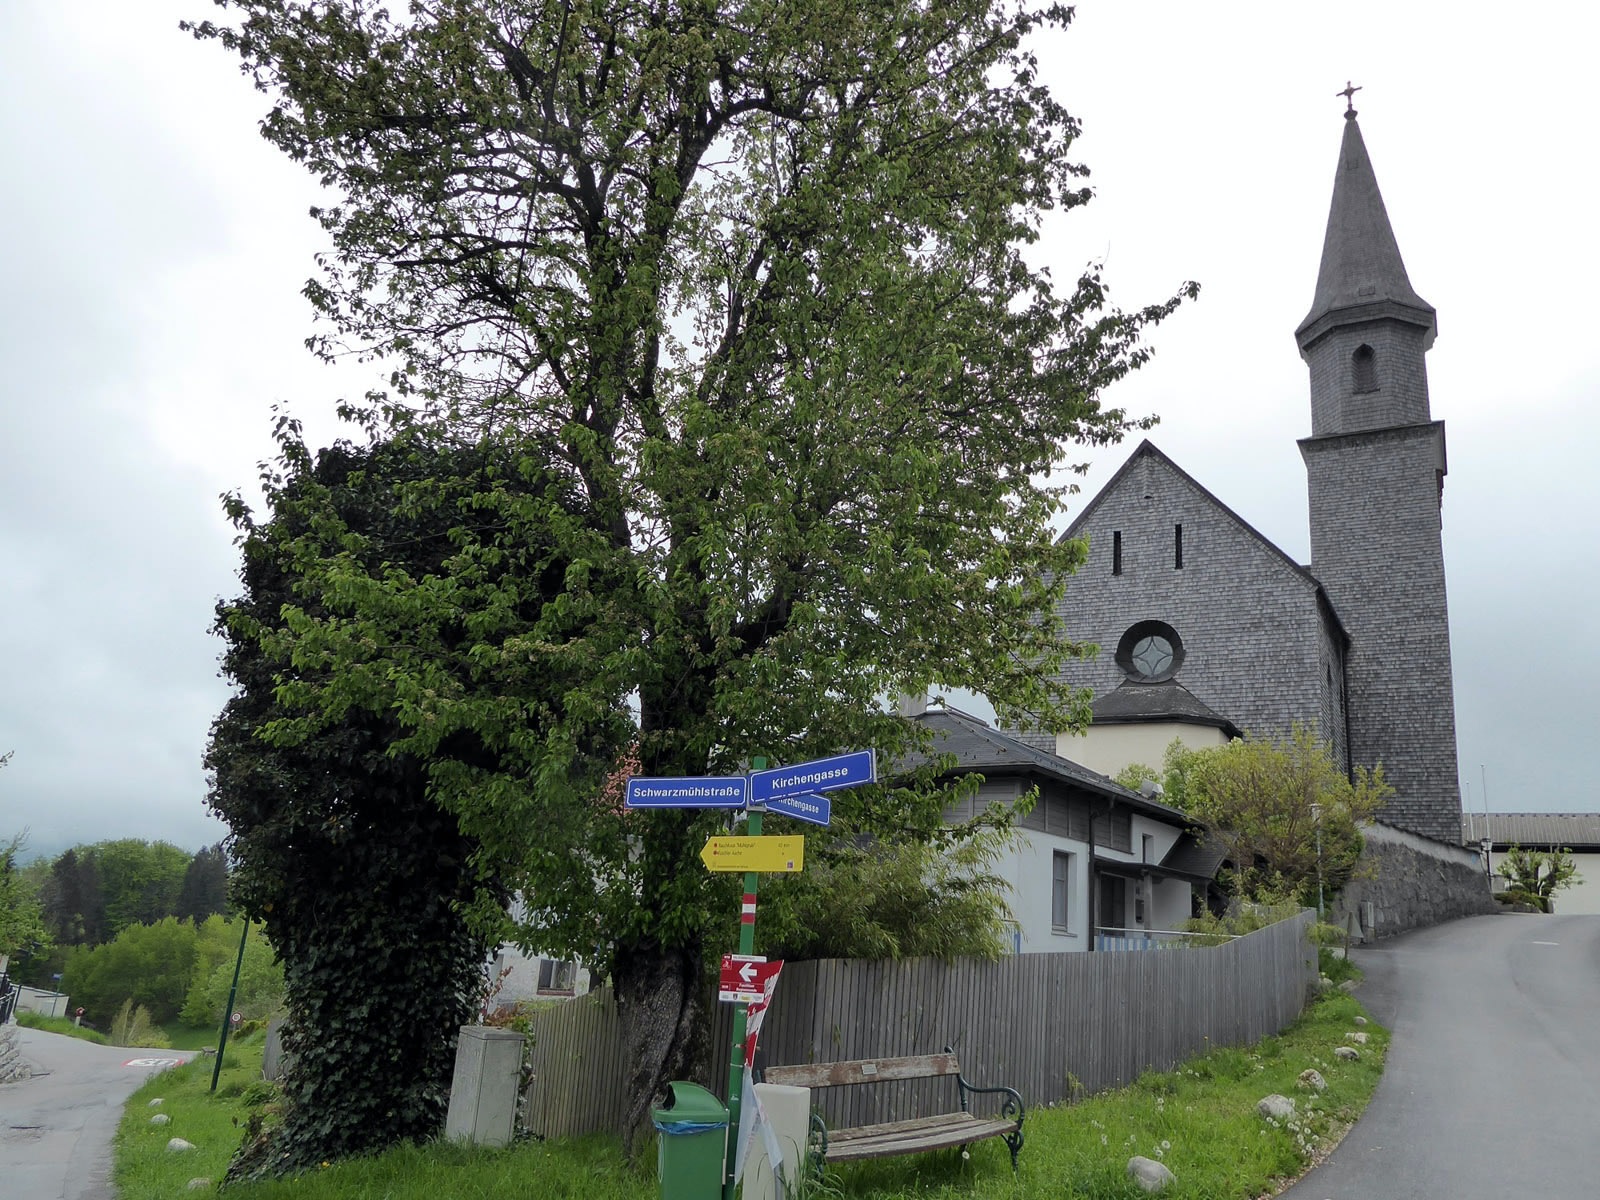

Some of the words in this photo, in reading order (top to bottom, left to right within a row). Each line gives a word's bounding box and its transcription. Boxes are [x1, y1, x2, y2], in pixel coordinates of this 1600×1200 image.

[772, 767, 848, 789] Kirchengasse
[633, 786, 740, 797] Schwarzmühlstraße
[778, 797, 819, 813] irchengasse
